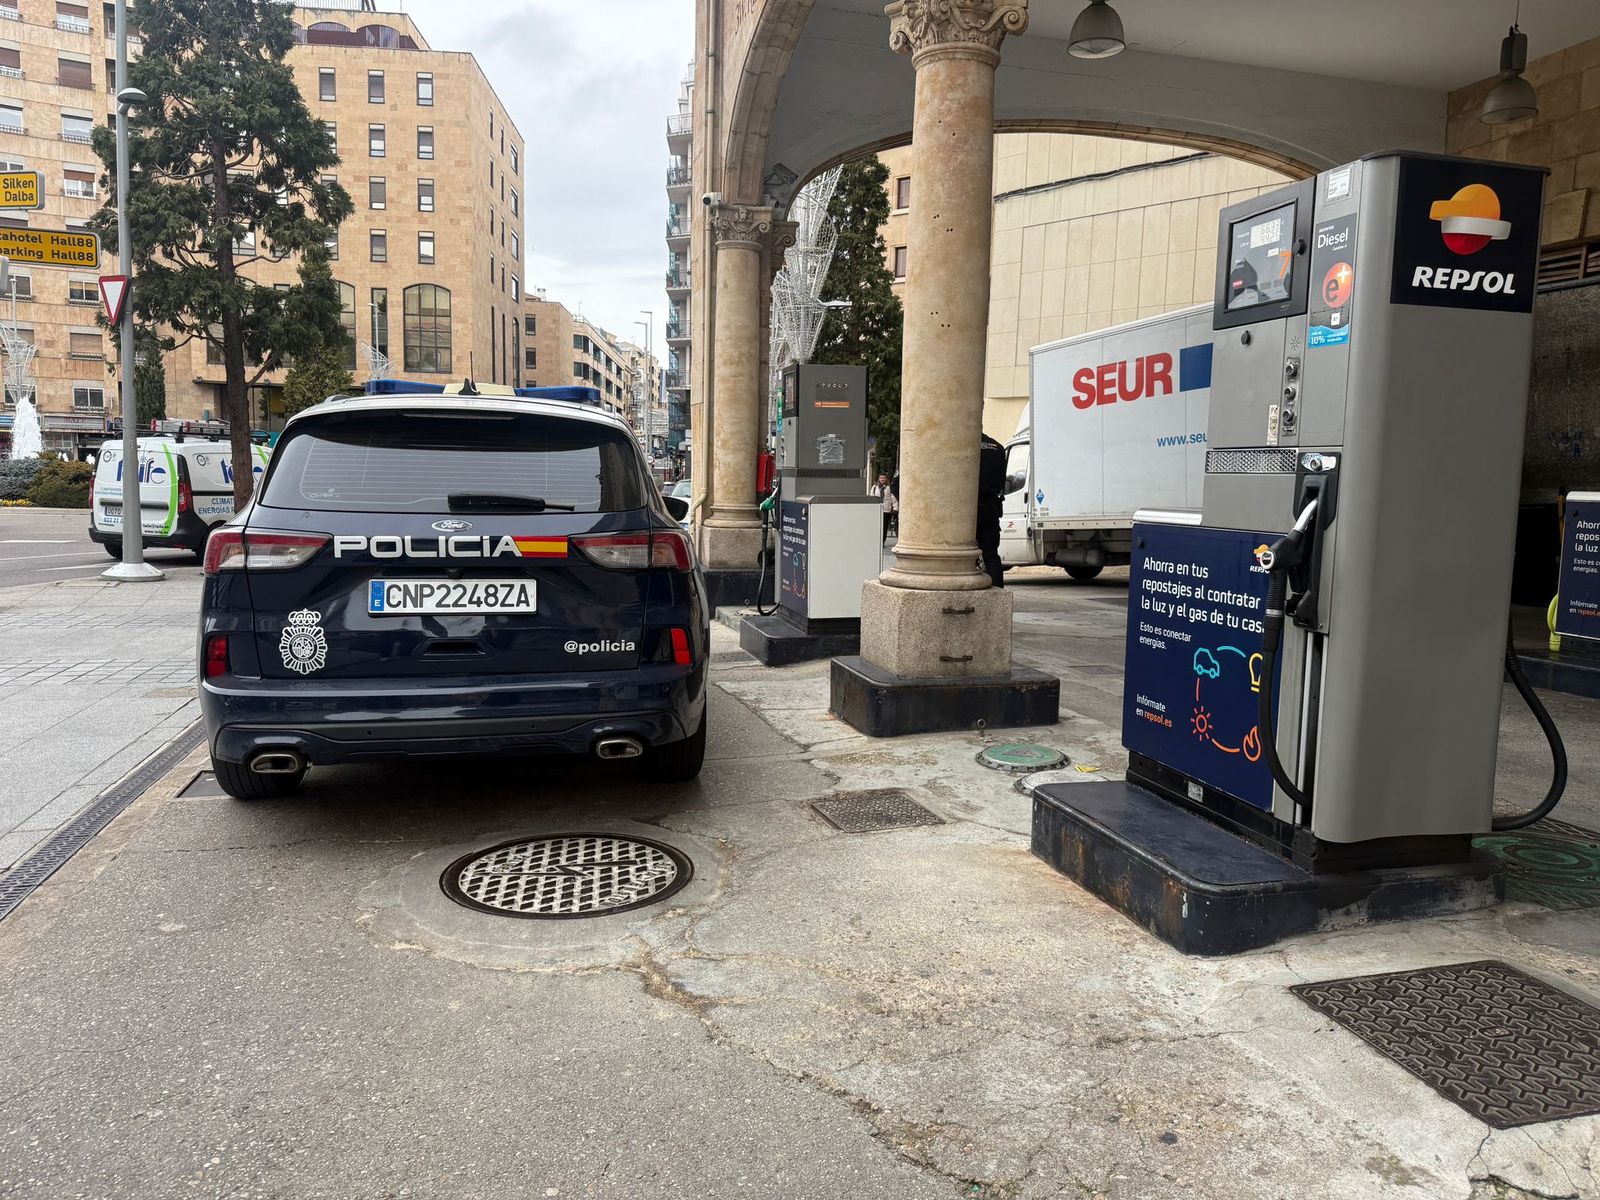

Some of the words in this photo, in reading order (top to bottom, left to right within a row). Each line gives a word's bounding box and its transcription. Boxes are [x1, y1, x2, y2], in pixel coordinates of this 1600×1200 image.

[3, 178, 34, 189] Silken
[5, 191, 34, 201] Dalba
[50, 236, 93, 248] Hall88
[1318, 228, 1348, 248] Diesel
[52, 249, 94, 261] Hall88
[1280, 250, 1293, 280] 7
[1412, 266, 1516, 294] REPSOL
[1072, 352, 1173, 410] SEUR
[1574, 542, 1583, 552] la
[1585, 544, 1598, 552] luz
[1144, 557, 1174, 575] Ahorra
[1176, 563, 1189, 575] en
[1192, 564, 1208, 578] tus
[386, 584, 530, 608] CNP2248ZA
[1142, 578, 1192, 598] repostajes
[1194, 585, 1204, 600] al
[1208, 589, 1261, 610] contratar
[1141, 595, 1150, 610] la
[1152, 597, 1166, 613] luz
[1168, 604, 1176, 618] y
[1176, 602, 1186, 618] el
[1189, 608, 1208, 623] gas
[1210, 609, 1224, 625] de
[1226, 612, 1239, 629] tu
[1139, 635, 1167, 650] energías.
[1140, 622, 1153, 634] Esto
[1154, 626, 1162, 636] es
[1163, 628, 1192, 643] conectar
[564, 640, 636, 655] @policia
[1136, 694, 1166, 713] Infórmate
[1136, 707, 1144, 716] en
[1144, 710, 1172, 728] repsol.es
